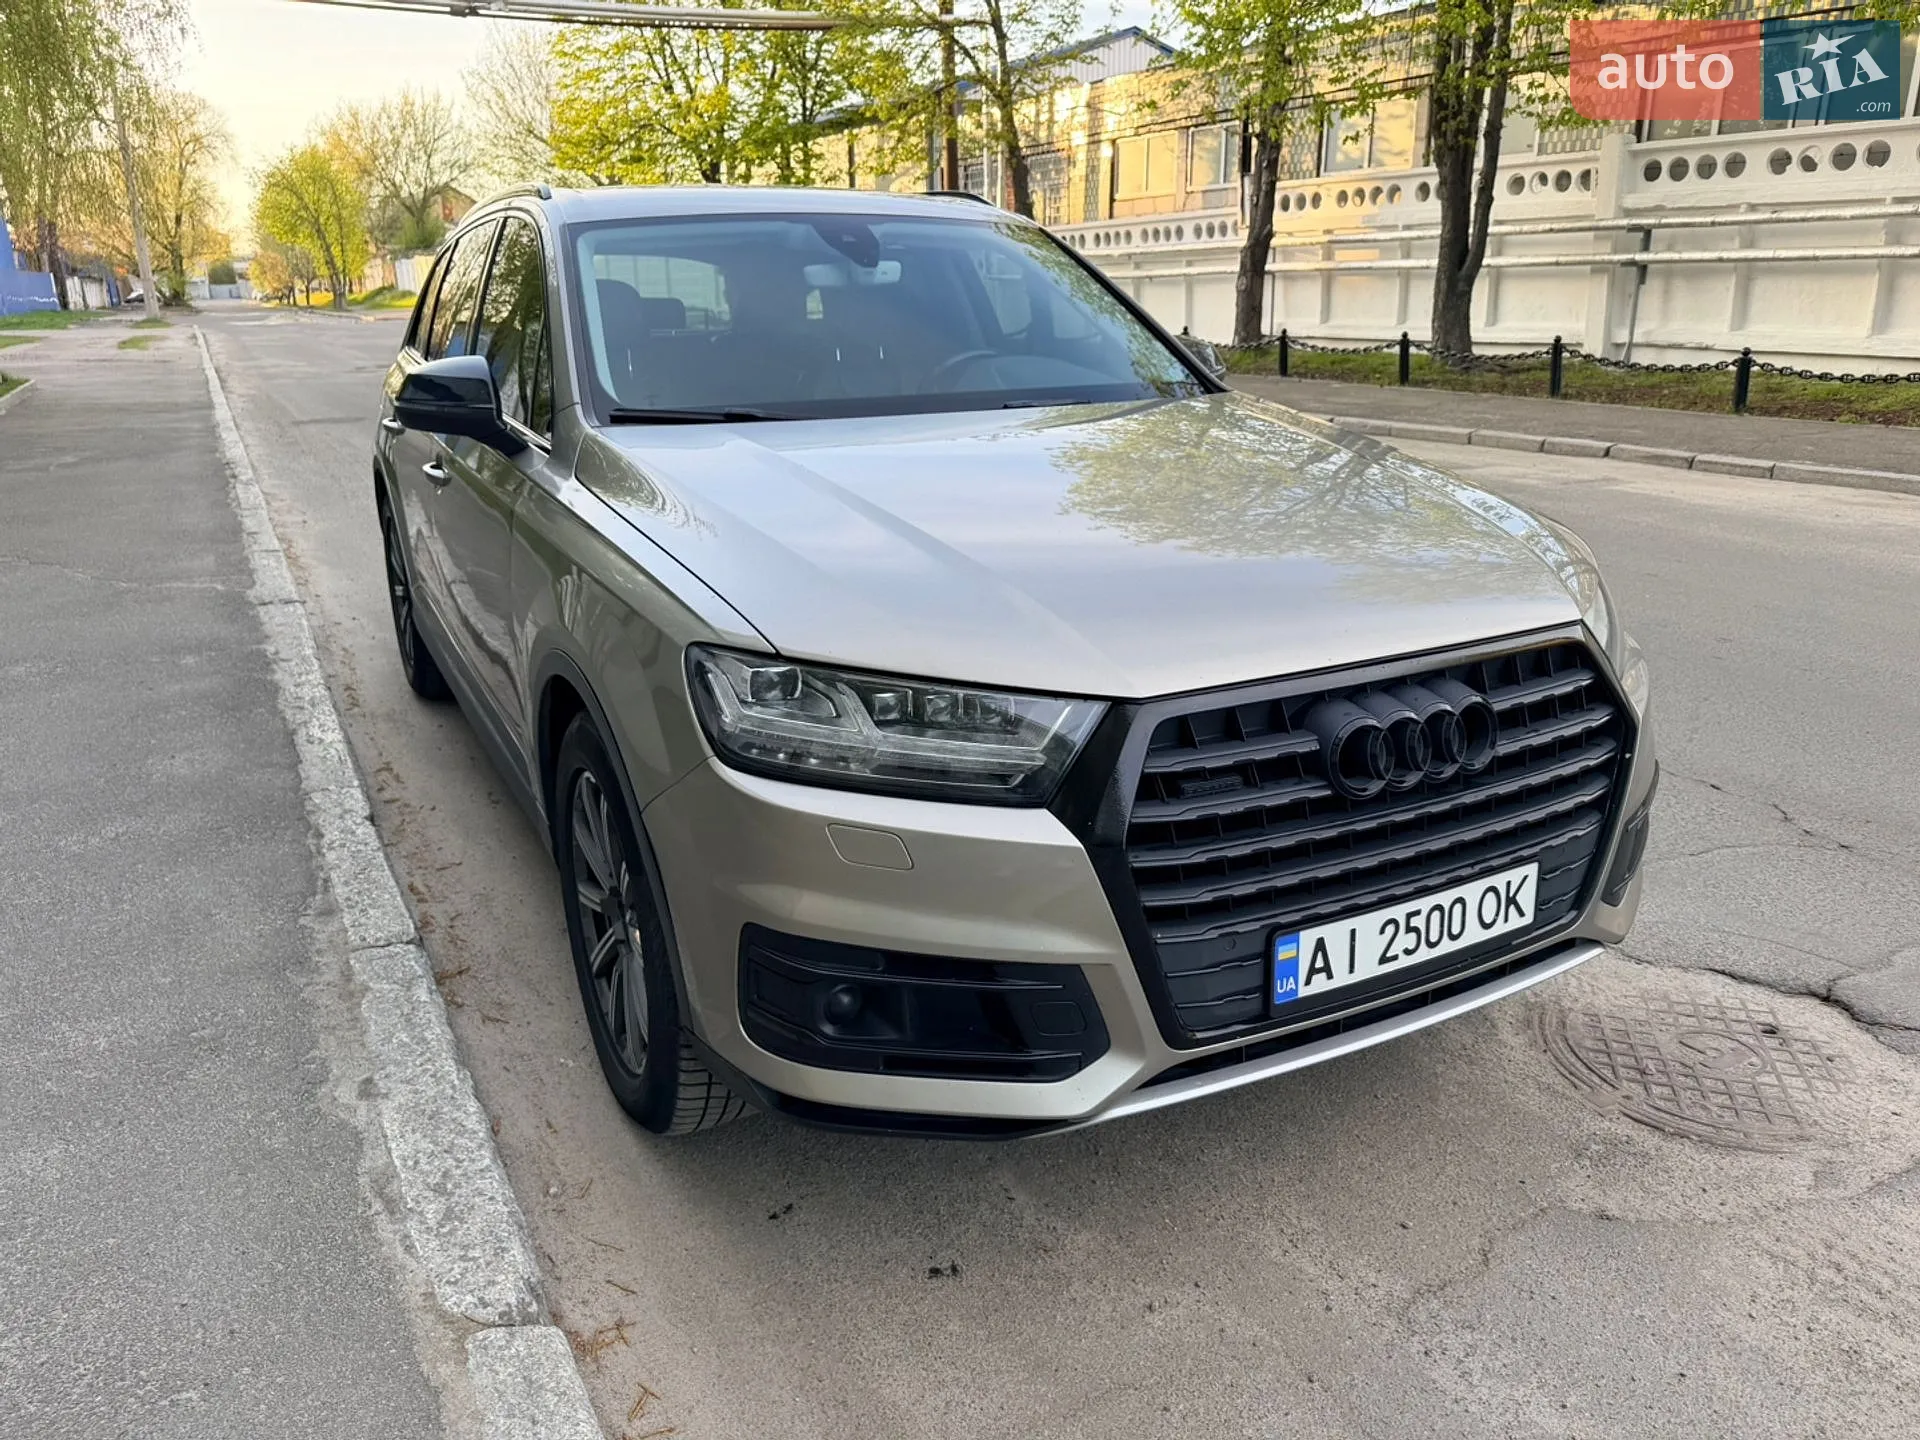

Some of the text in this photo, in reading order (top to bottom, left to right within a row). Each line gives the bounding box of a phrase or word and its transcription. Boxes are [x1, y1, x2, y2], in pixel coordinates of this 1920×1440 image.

[1304, 875, 1529, 987] AI 2500 OK
[1277, 976, 1296, 993] UA
